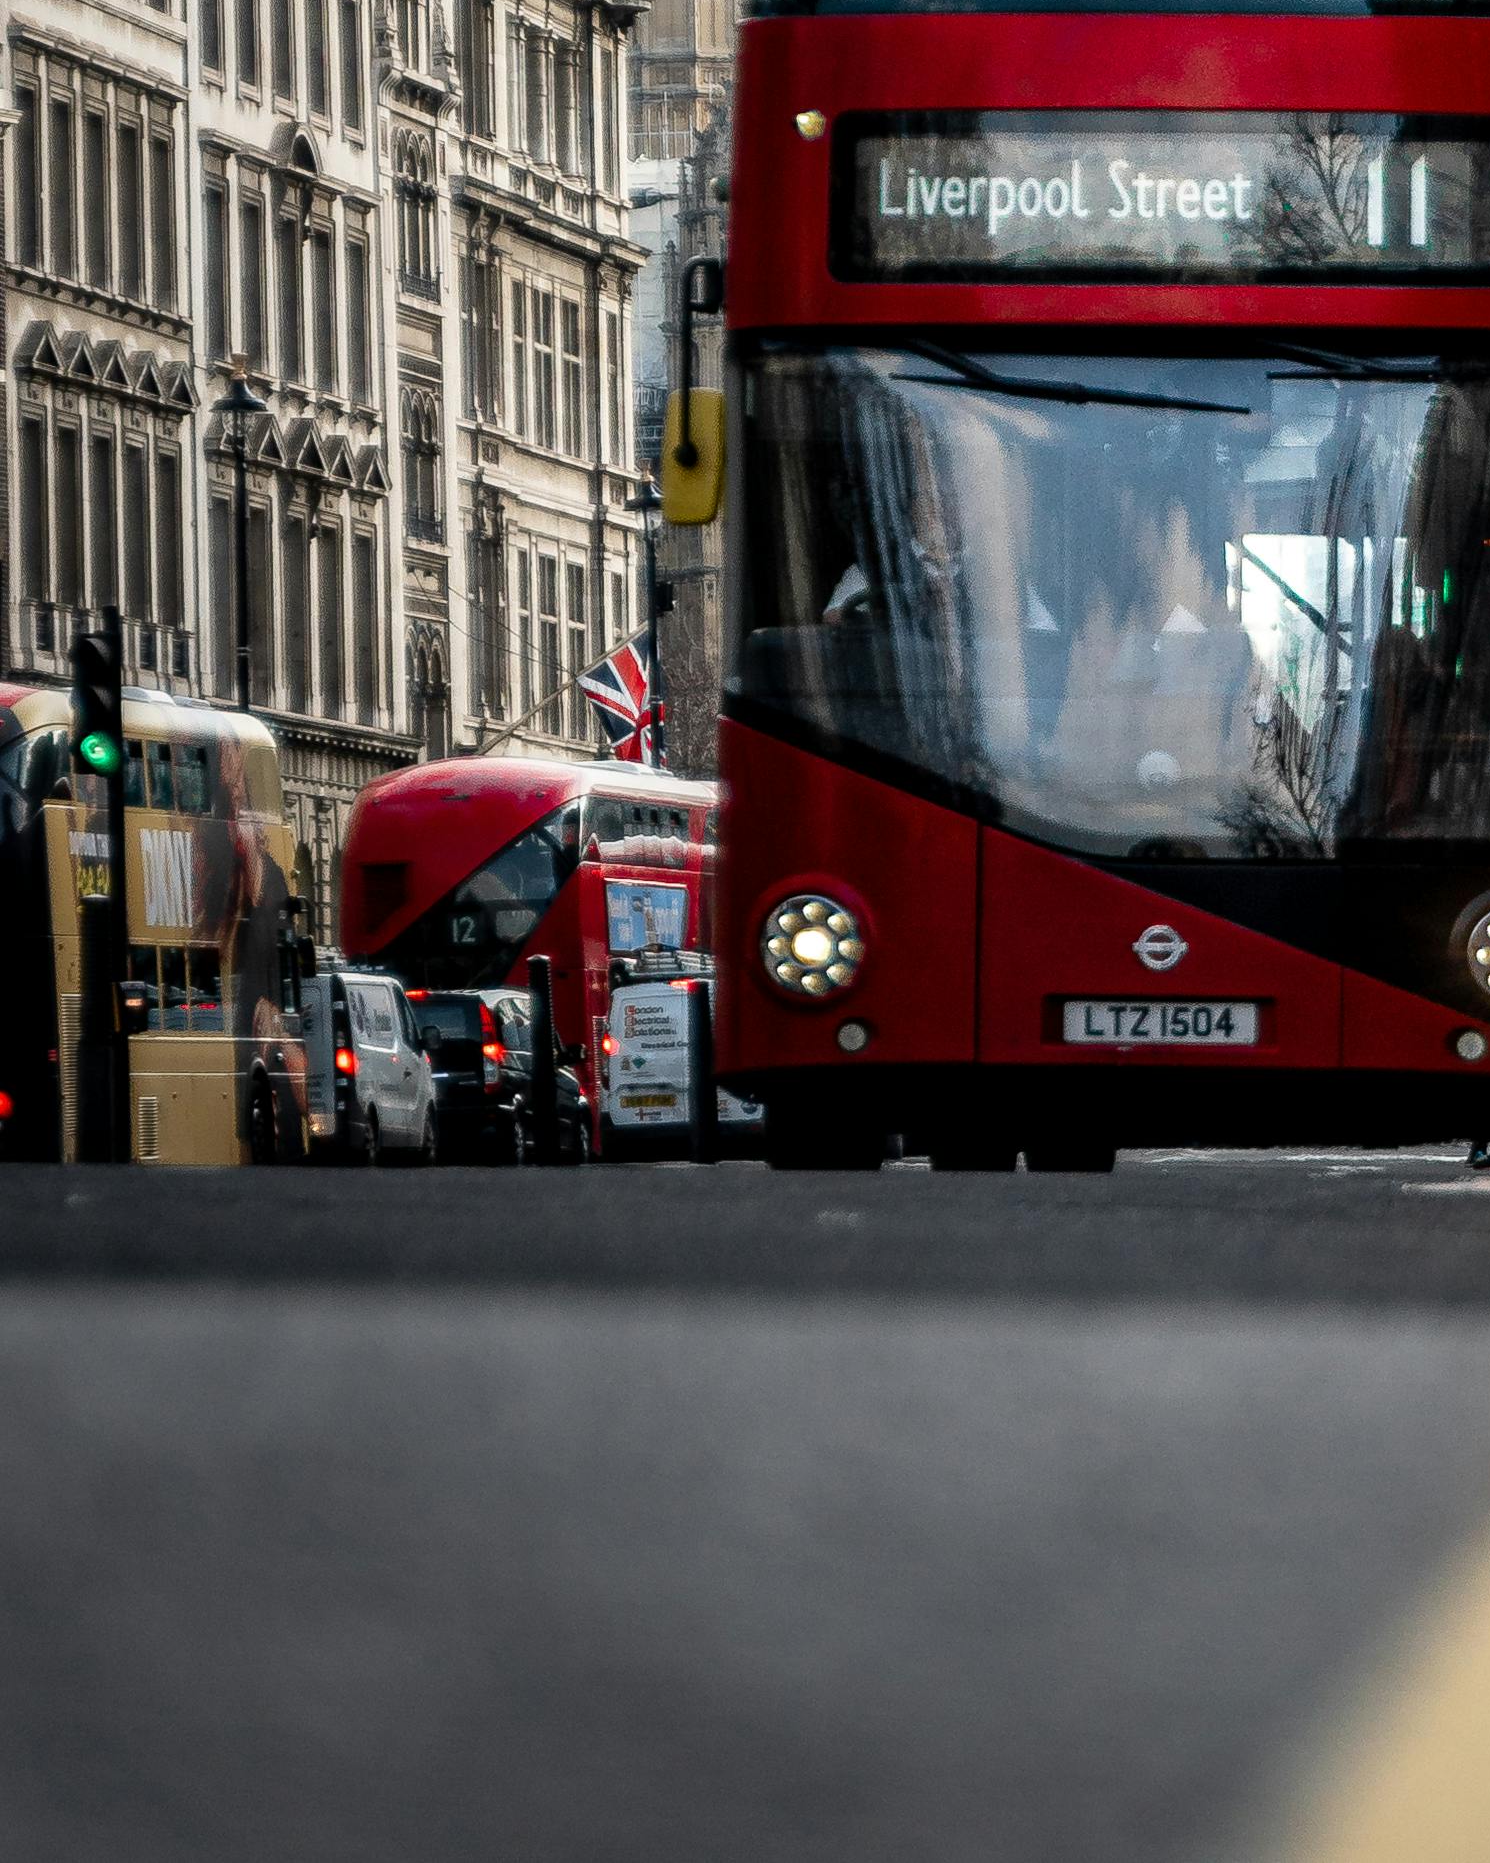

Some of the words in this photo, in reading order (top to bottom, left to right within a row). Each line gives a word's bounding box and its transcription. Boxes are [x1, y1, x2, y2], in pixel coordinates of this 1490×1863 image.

[879, 158, 1089, 235] Liverpool
[1107, 159, 1253, 221] Street
[1367, 154, 1428, 247] 11
[452, 916, 476, 943] 12
[624, 1005, 663, 1016] London
[1084, 1006, 1149, 1037] LTZ
[1160, 1006, 1235, 1038] 1504
